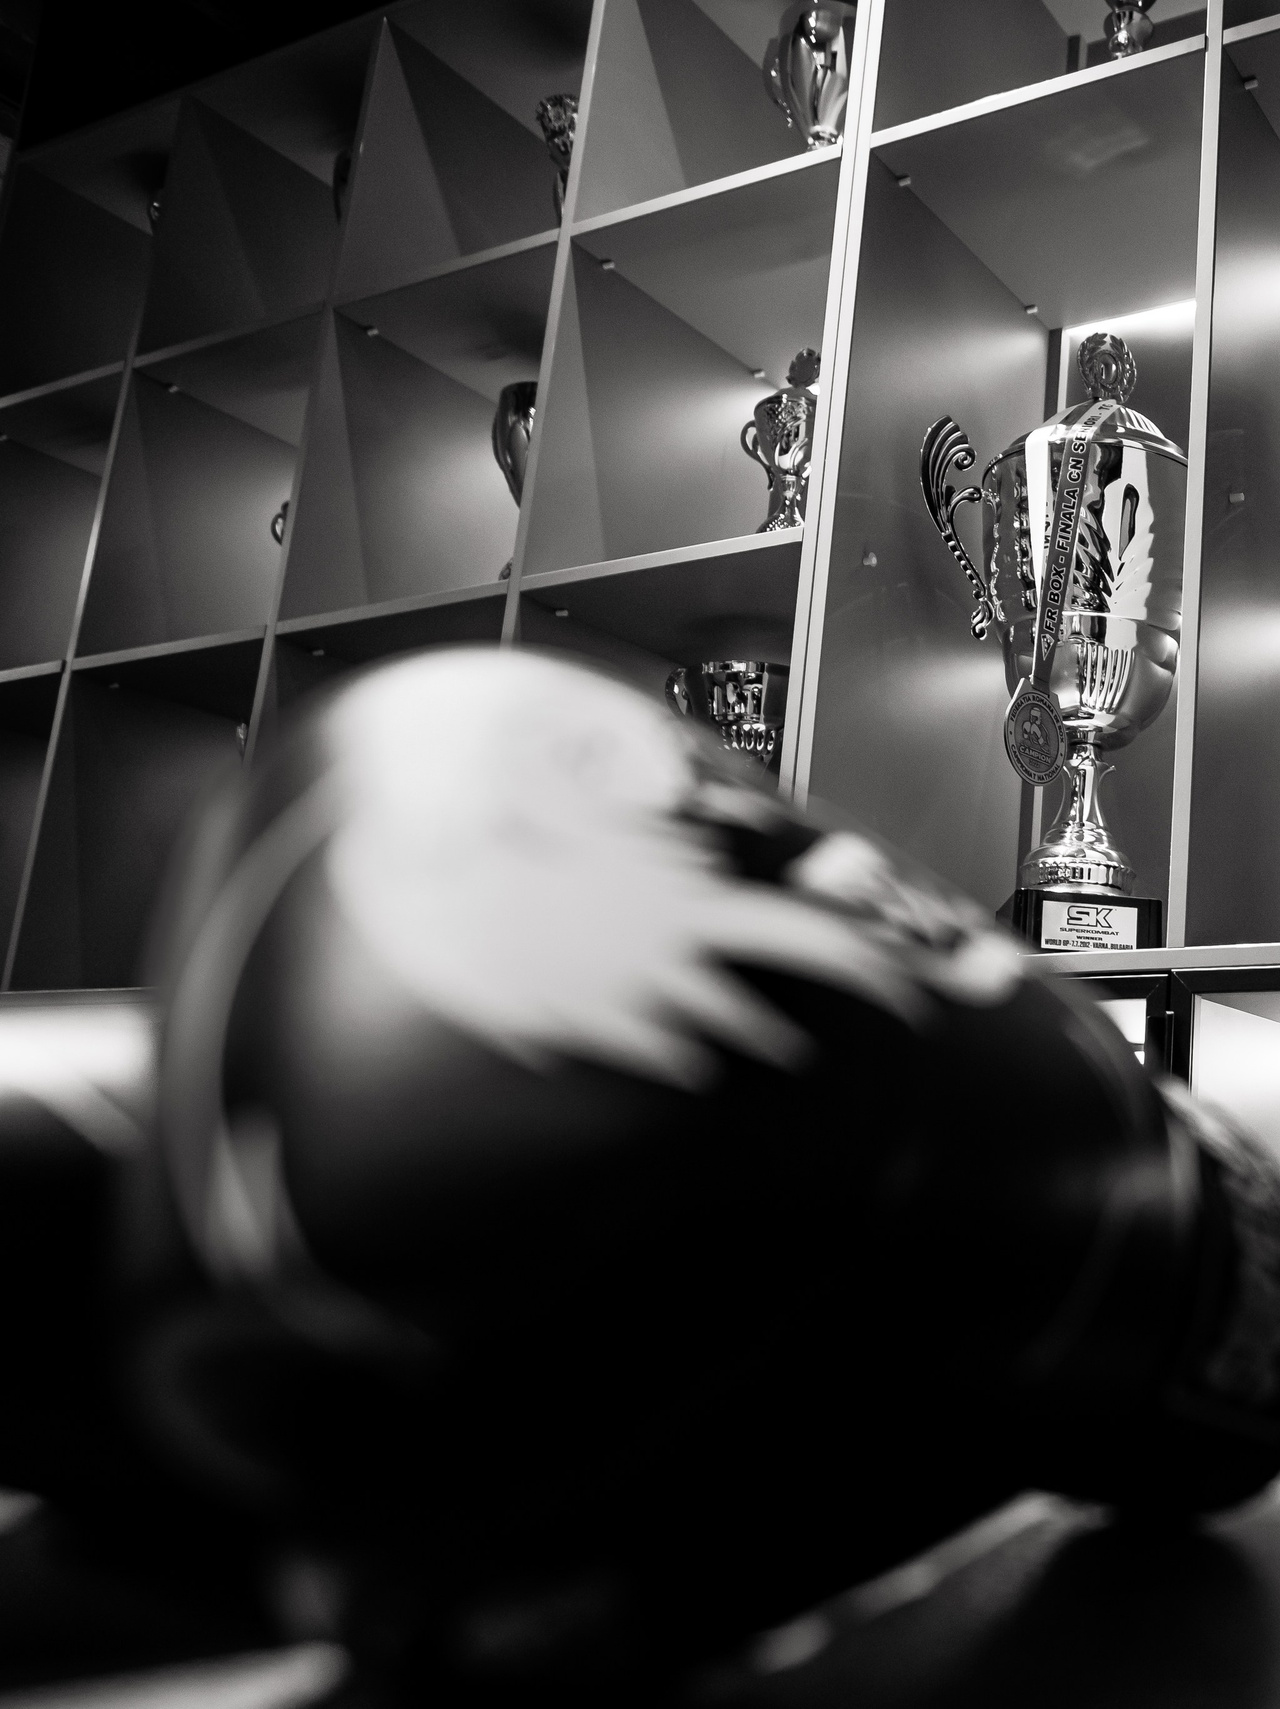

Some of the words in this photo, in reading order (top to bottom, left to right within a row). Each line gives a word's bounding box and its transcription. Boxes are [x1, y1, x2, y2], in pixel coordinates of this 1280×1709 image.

[1067, 457, 1084, 483] CN
[1055, 487, 1080, 552] FINALA
[1048, 565, 1066, 604] BOX
[1044, 607, 1059, 633] FR
[1032, 694, 1054, 715] ROMANA
[1019, 745, 1051, 764] CAMPION
[1066, 905, 1113, 928] SK
[1044, 938, 1061, 946] WORLD
[1059, 927, 1119, 936] SUPERKOMBAT
